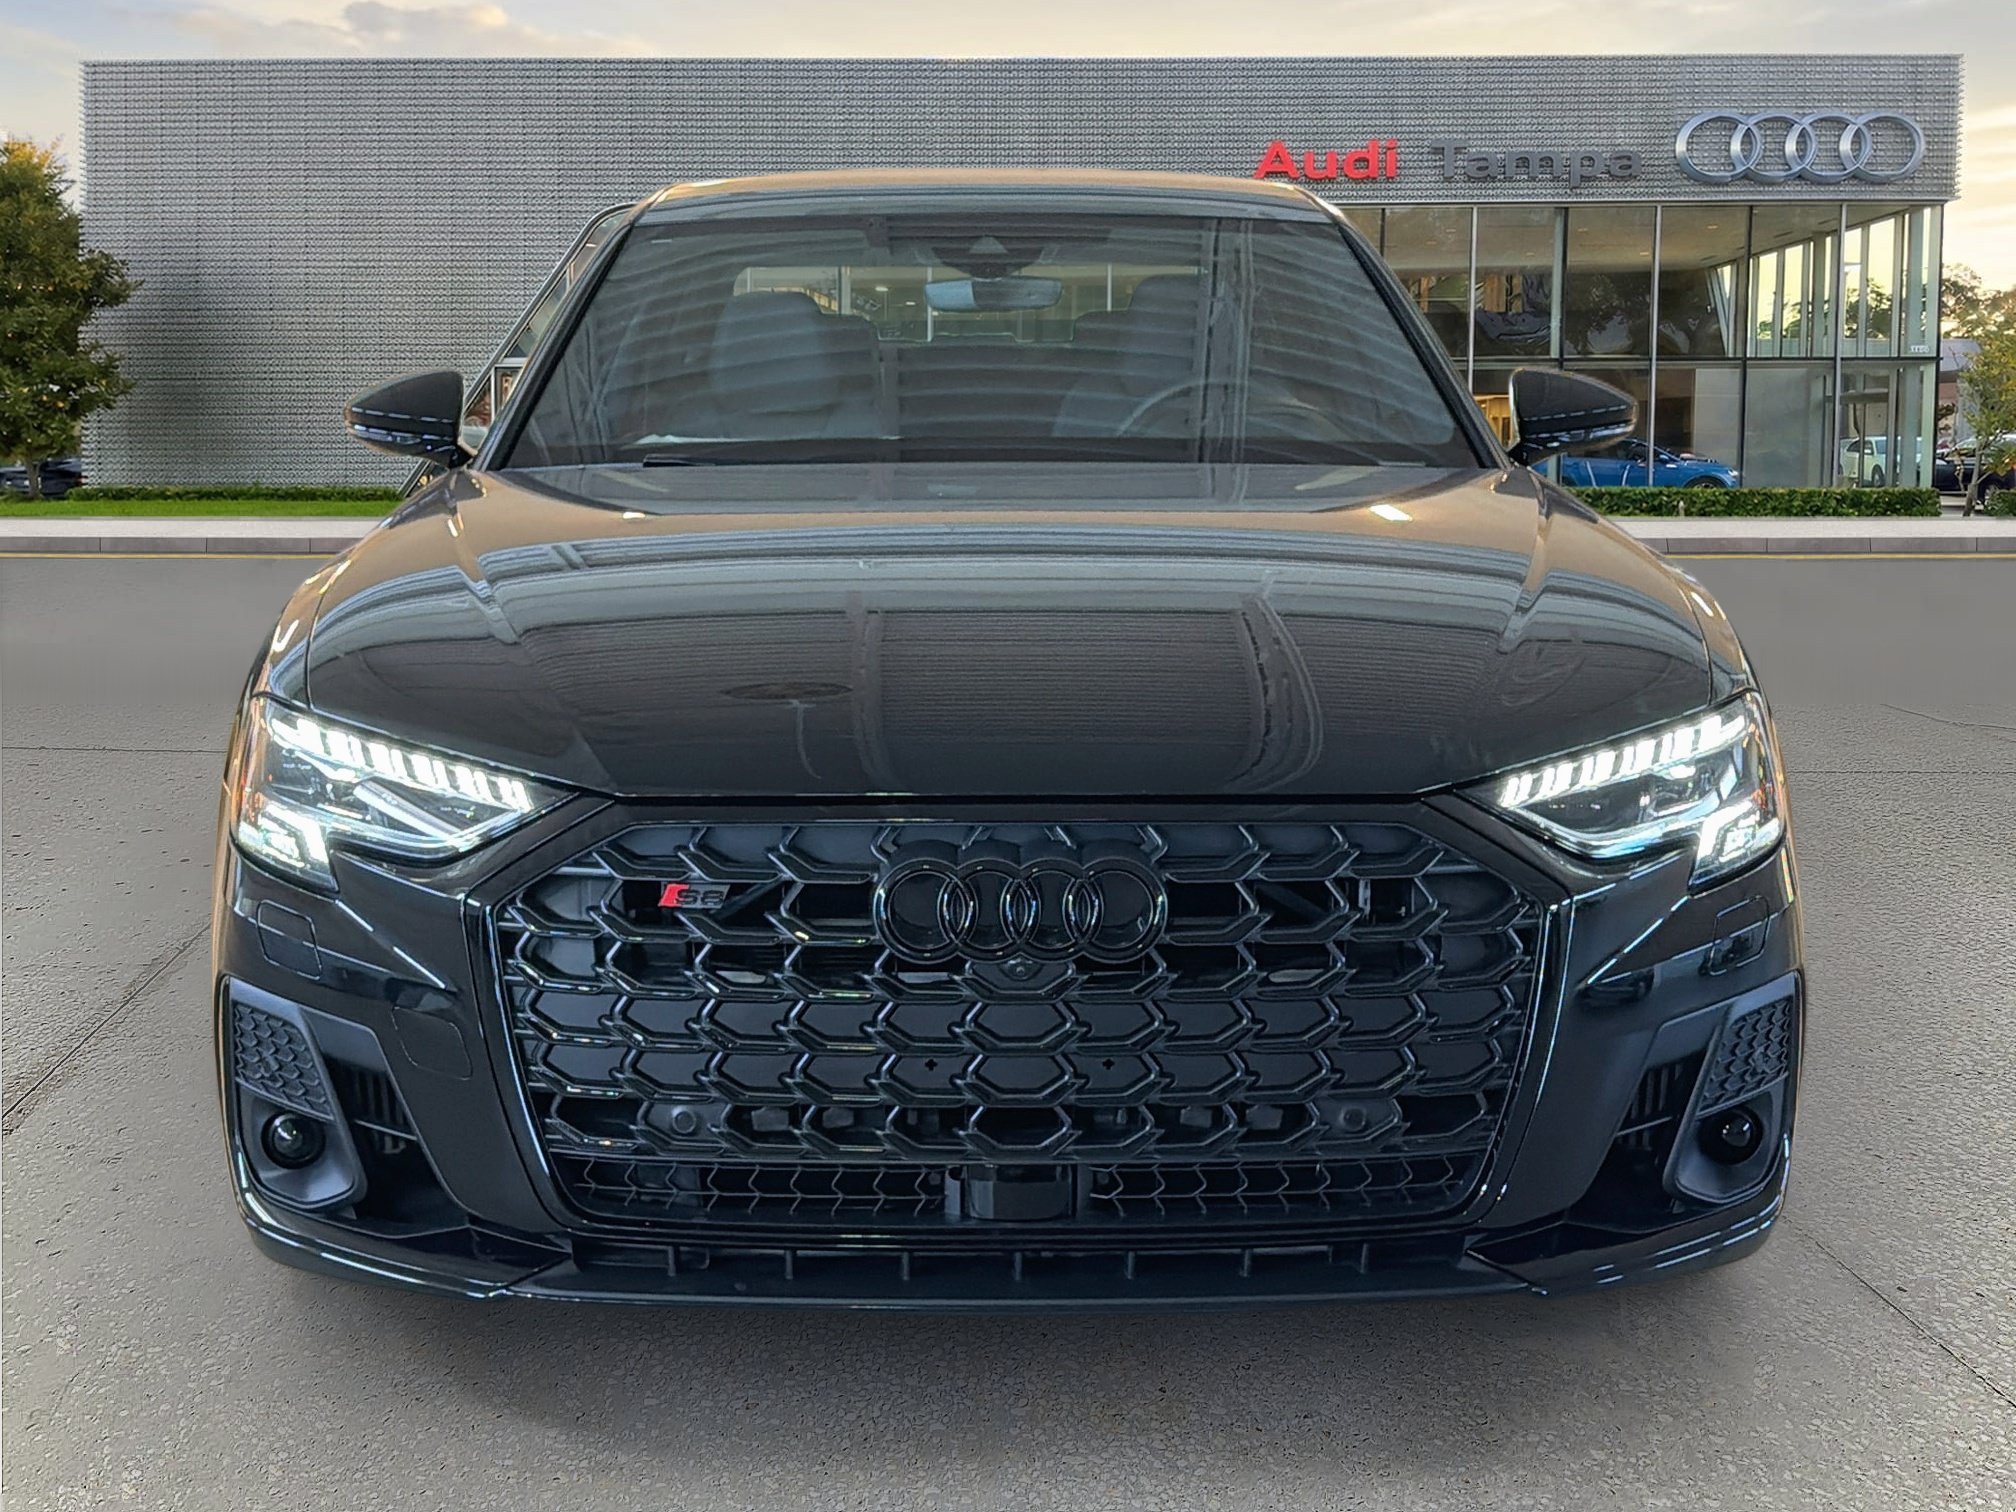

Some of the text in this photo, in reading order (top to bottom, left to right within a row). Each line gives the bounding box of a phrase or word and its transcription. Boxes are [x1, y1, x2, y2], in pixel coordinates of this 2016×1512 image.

[1254, 138, 1642, 189] Audi Tampa
[674, 888, 727, 907] S8
